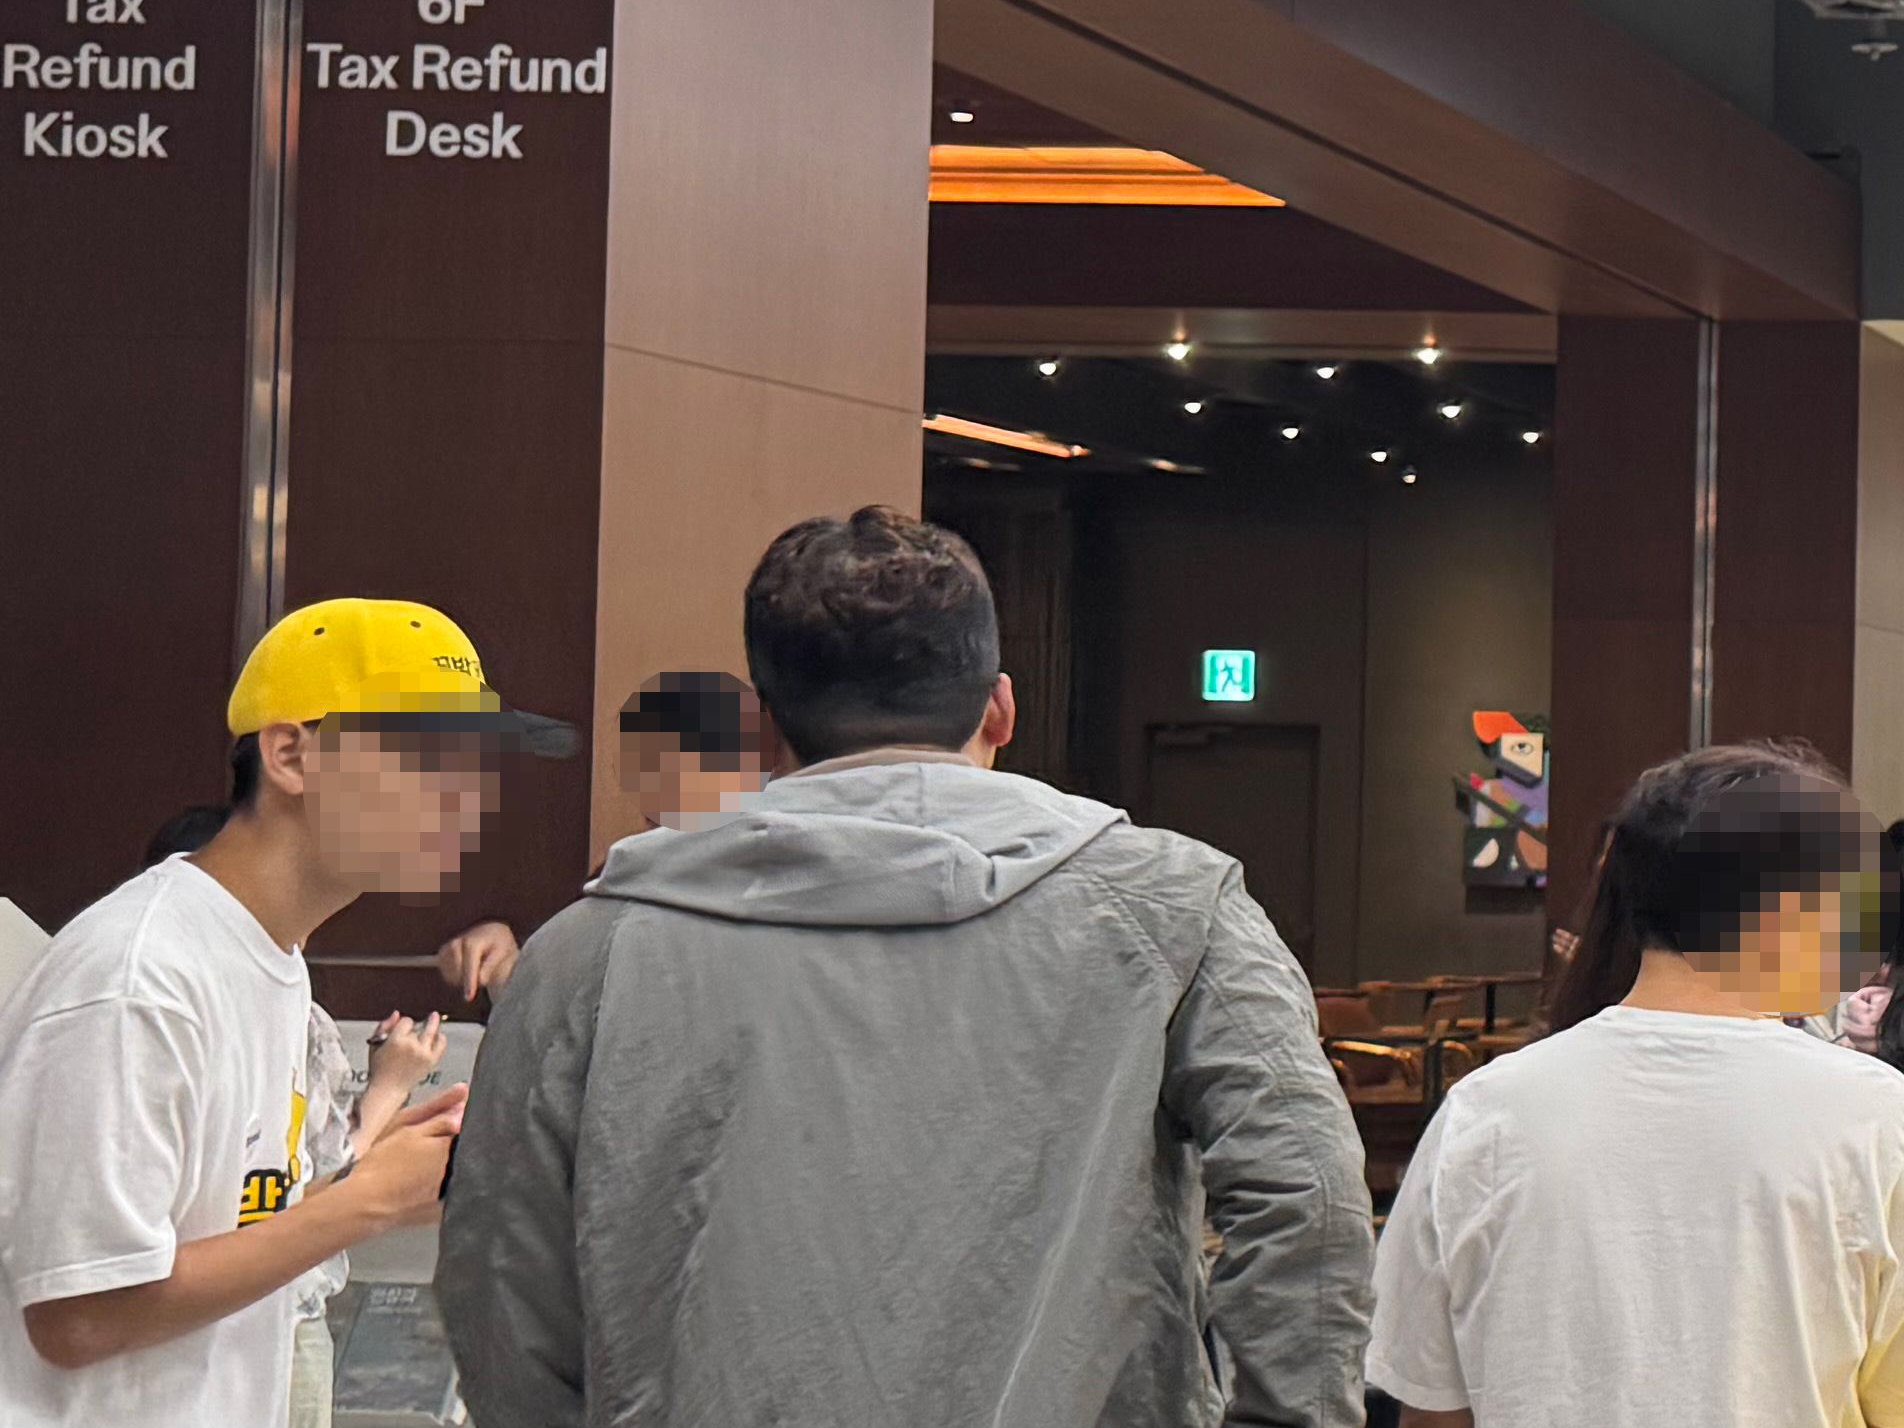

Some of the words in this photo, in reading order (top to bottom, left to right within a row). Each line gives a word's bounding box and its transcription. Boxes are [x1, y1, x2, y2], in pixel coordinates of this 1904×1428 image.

[2, 44, 196, 91] Refund
[307, 43, 399, 91] Tax
[412, 45, 606, 94] Refund
[23, 112, 168, 159] Kiosk
[385, 111, 523, 159] Desk
